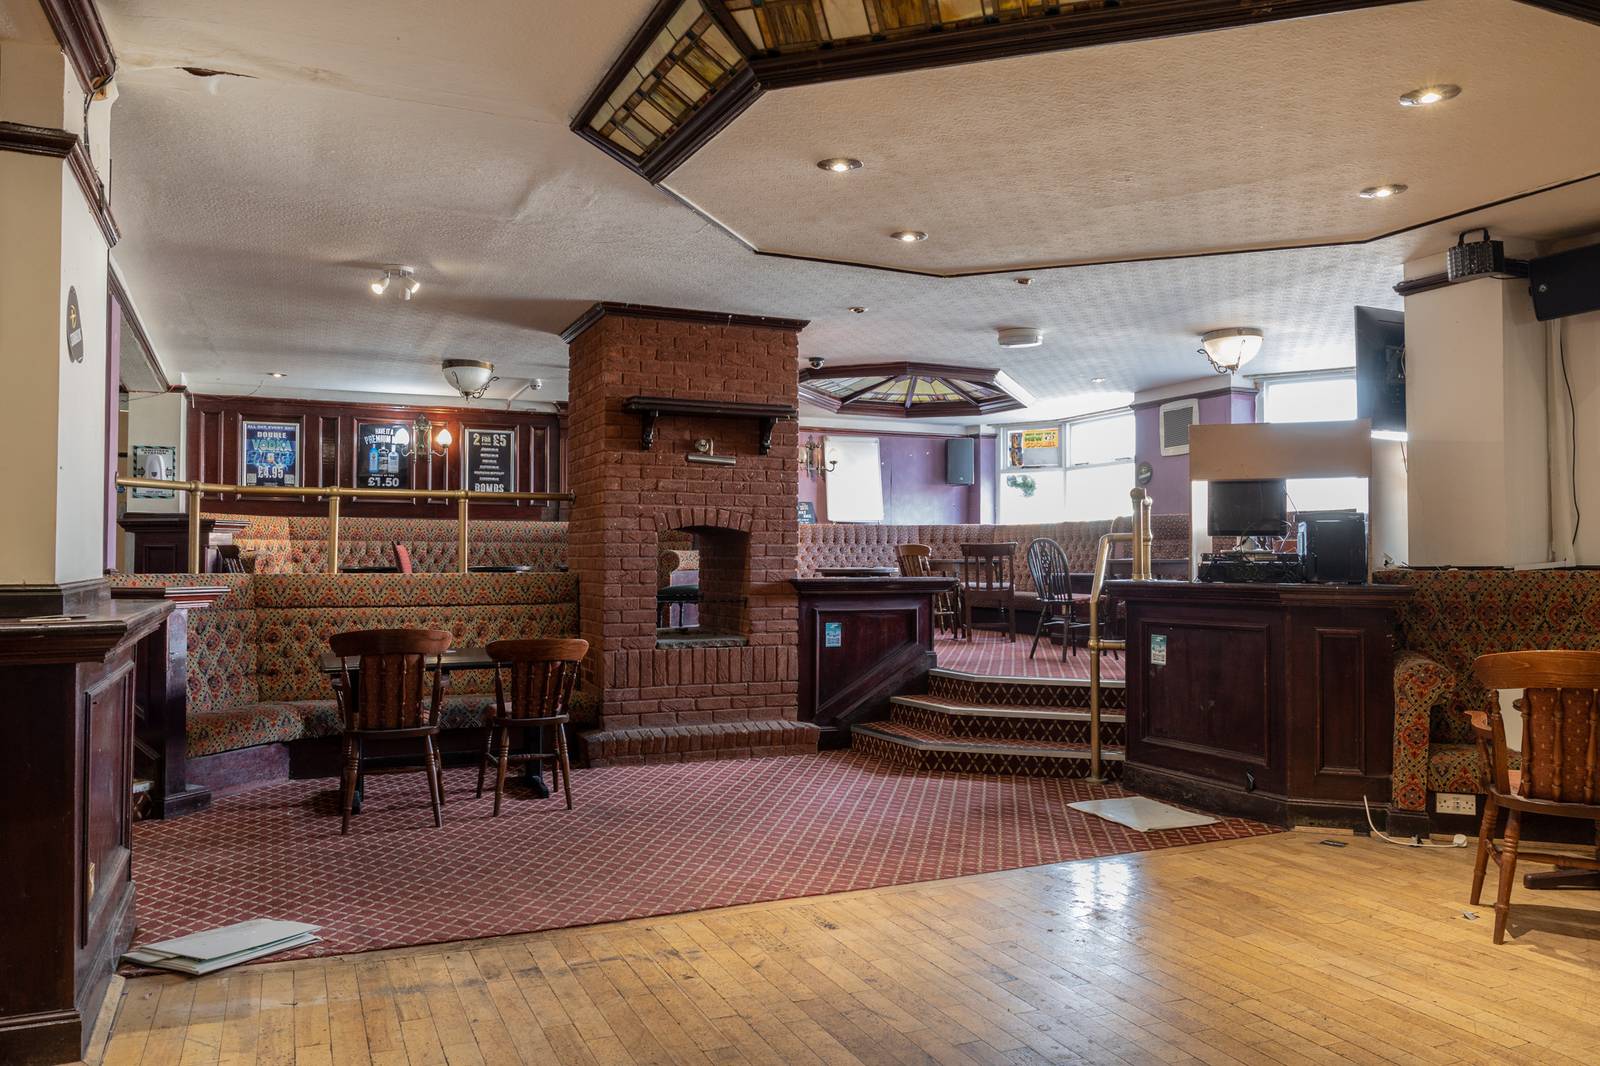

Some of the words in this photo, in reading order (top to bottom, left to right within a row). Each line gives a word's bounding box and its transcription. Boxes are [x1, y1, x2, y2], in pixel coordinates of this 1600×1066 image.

[251, 439, 292, 451] VODKA
[364, 434, 391, 445] PREMIUM
[473, 433, 480, 446] 2
[493, 434, 507, 447] £5
[257, 465, 284, 478] £4.95
[367, 477, 400, 487] £1.50
[474, 483, 505, 493] BOMBS
